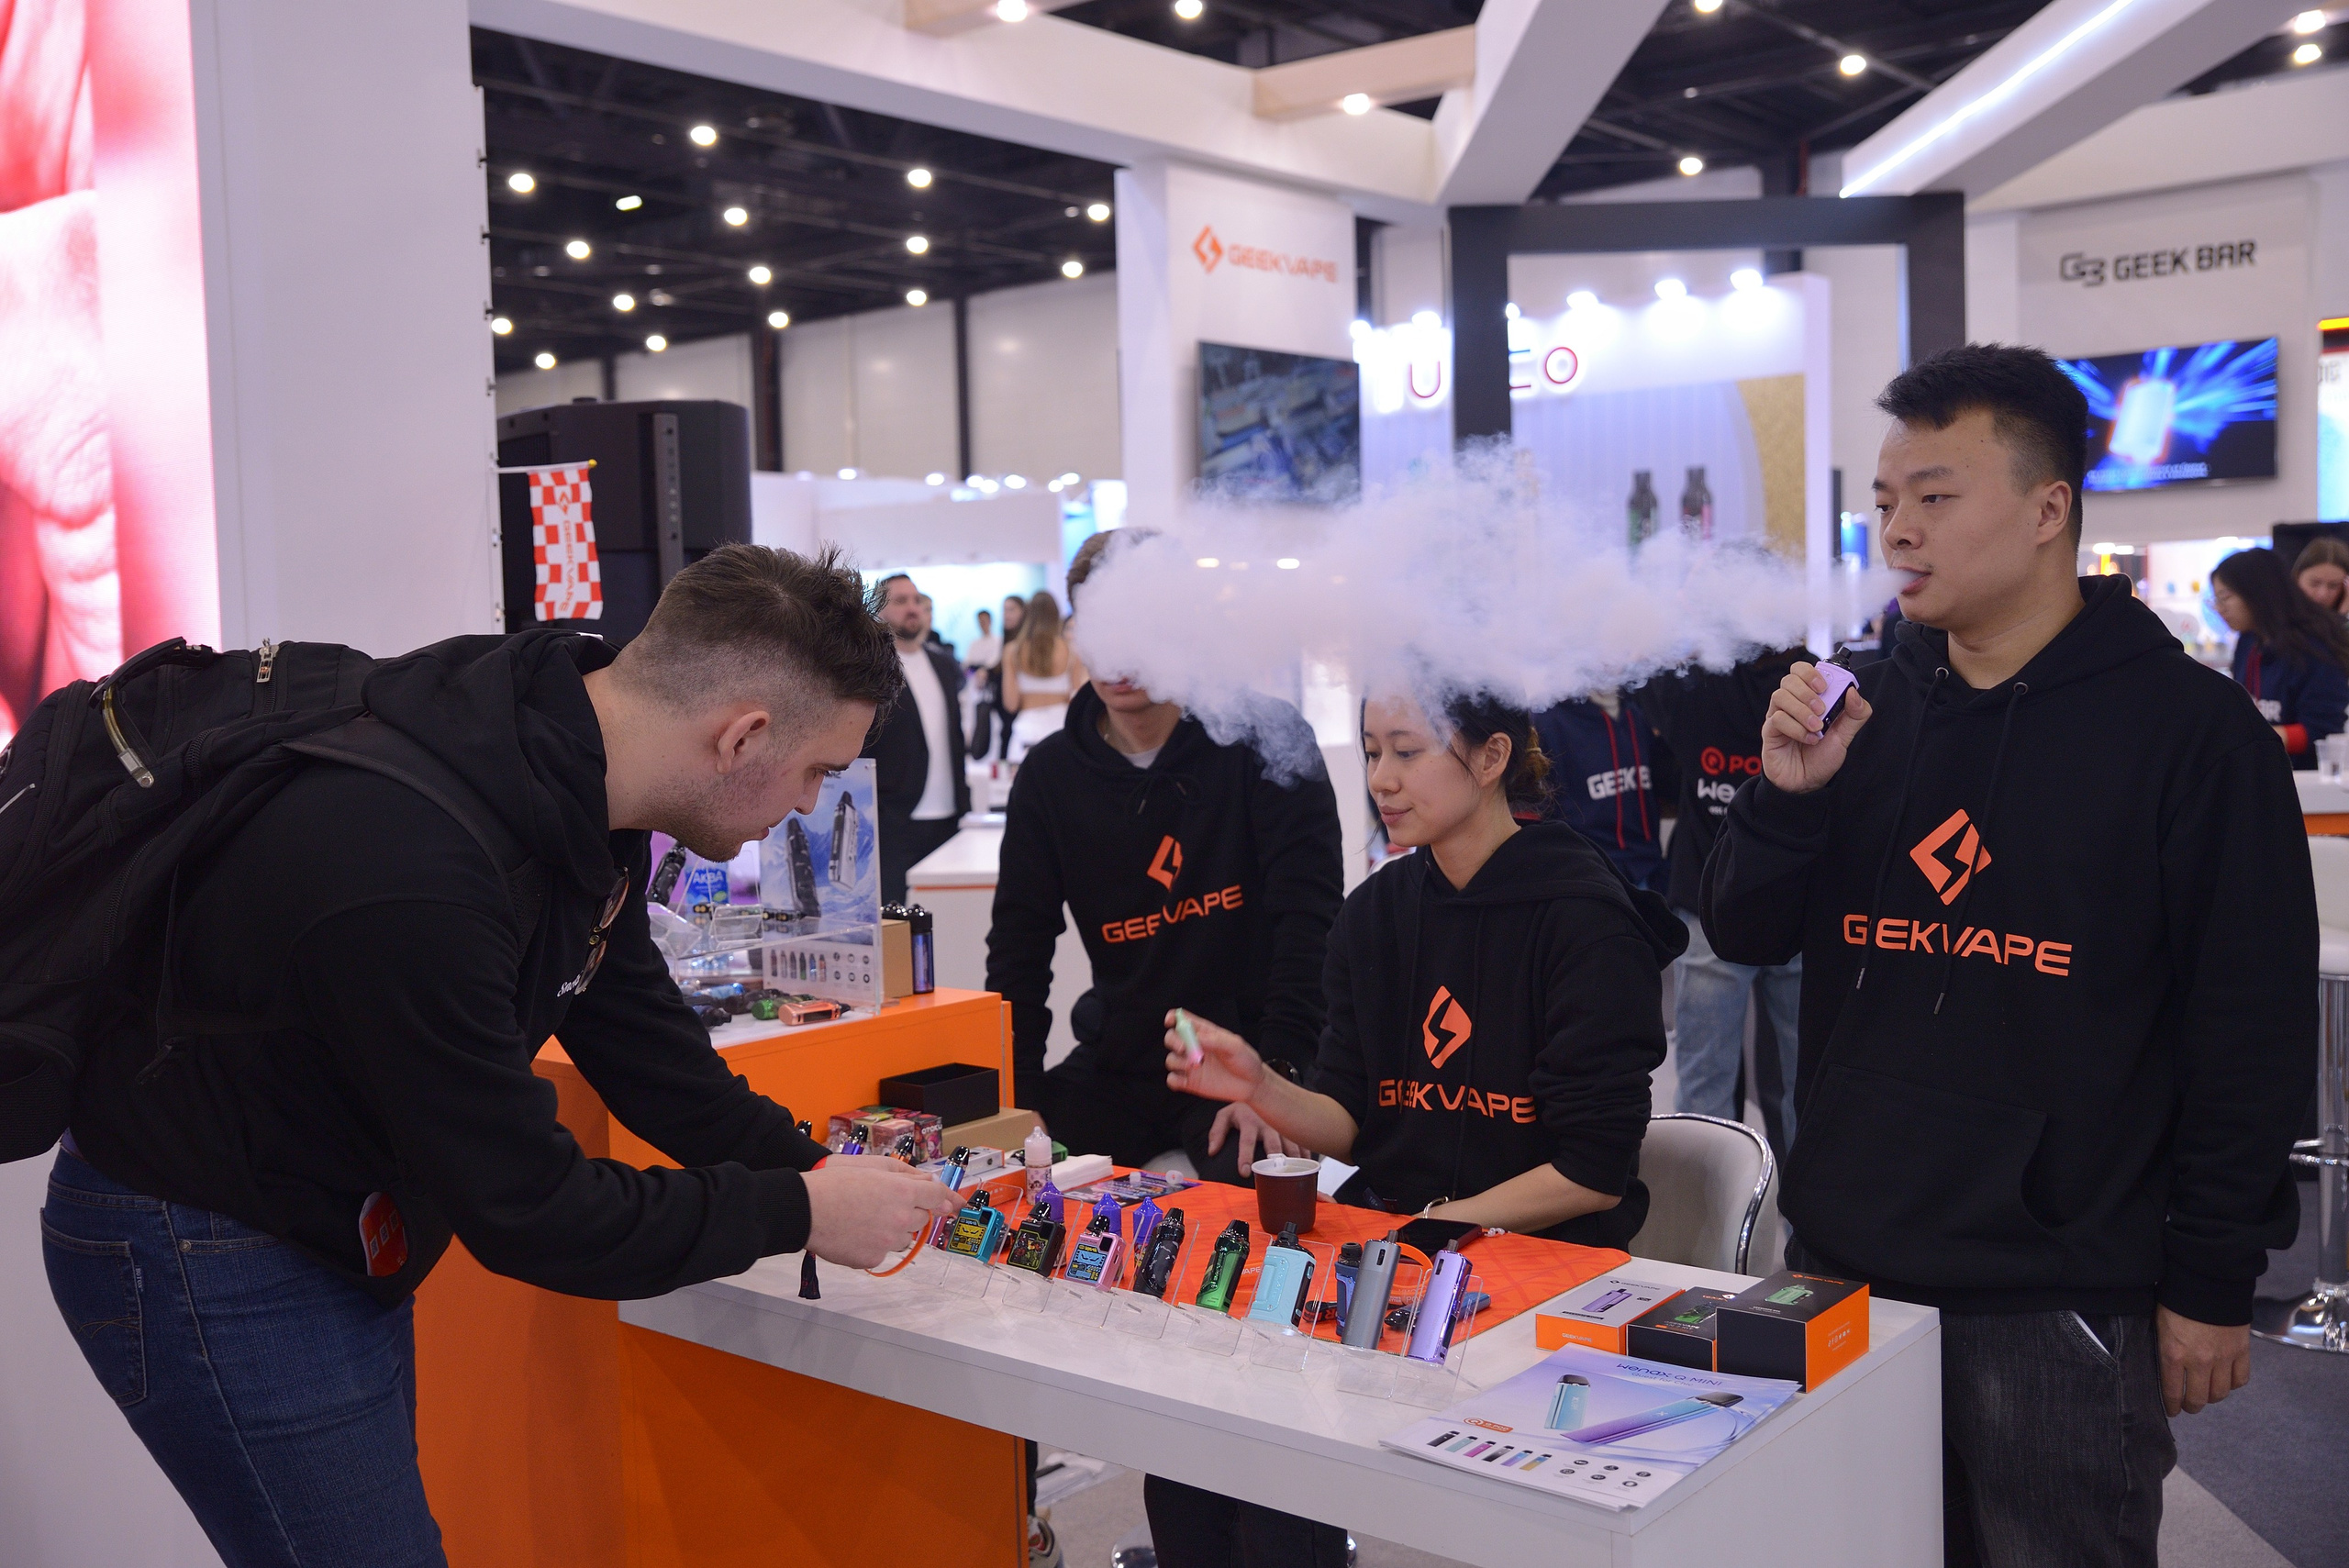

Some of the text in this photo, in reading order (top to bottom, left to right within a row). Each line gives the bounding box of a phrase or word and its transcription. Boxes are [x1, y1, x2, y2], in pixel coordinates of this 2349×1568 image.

[1228, 244, 1337, 283] GEEKVAPE
[2113, 248, 2188, 281] GEEK
[2197, 240, 2255, 271] BAR
[1102, 884, 1243, 943] GEEVAPE
[1842, 914, 2072, 976] GEKVAPE
[1562, 1332, 1592, 1342] GEEKVAPE
[1631, 1372, 1657, 1380] Quest
[1689, 1376, 1723, 1386] MINI
